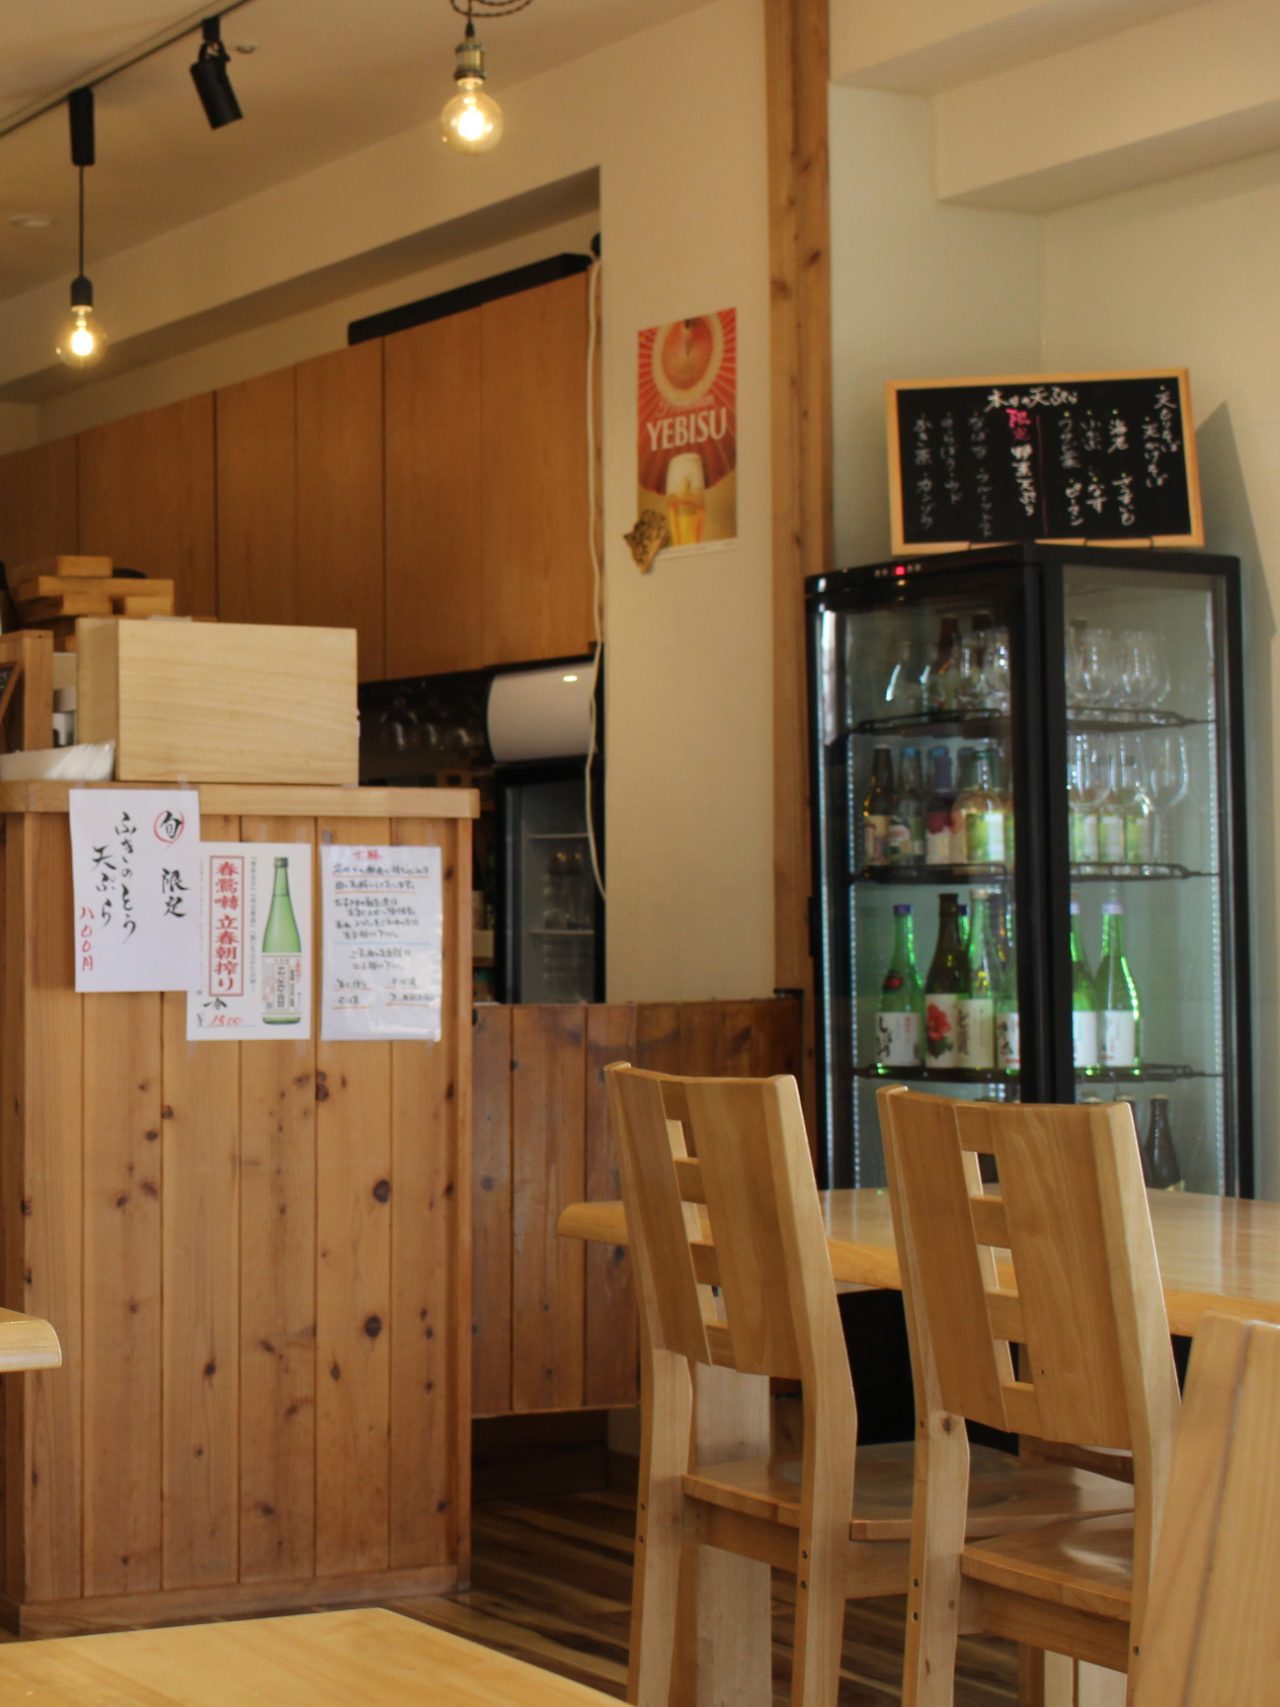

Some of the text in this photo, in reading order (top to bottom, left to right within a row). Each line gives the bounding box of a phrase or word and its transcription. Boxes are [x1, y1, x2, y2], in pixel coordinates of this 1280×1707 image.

[646, 406, 727, 451] YEBISU
[92, 845, 117, 926] 天ぷら
[114, 811, 137, 945] ふきのとう
[160, 811, 190, 917] 旬 限定
